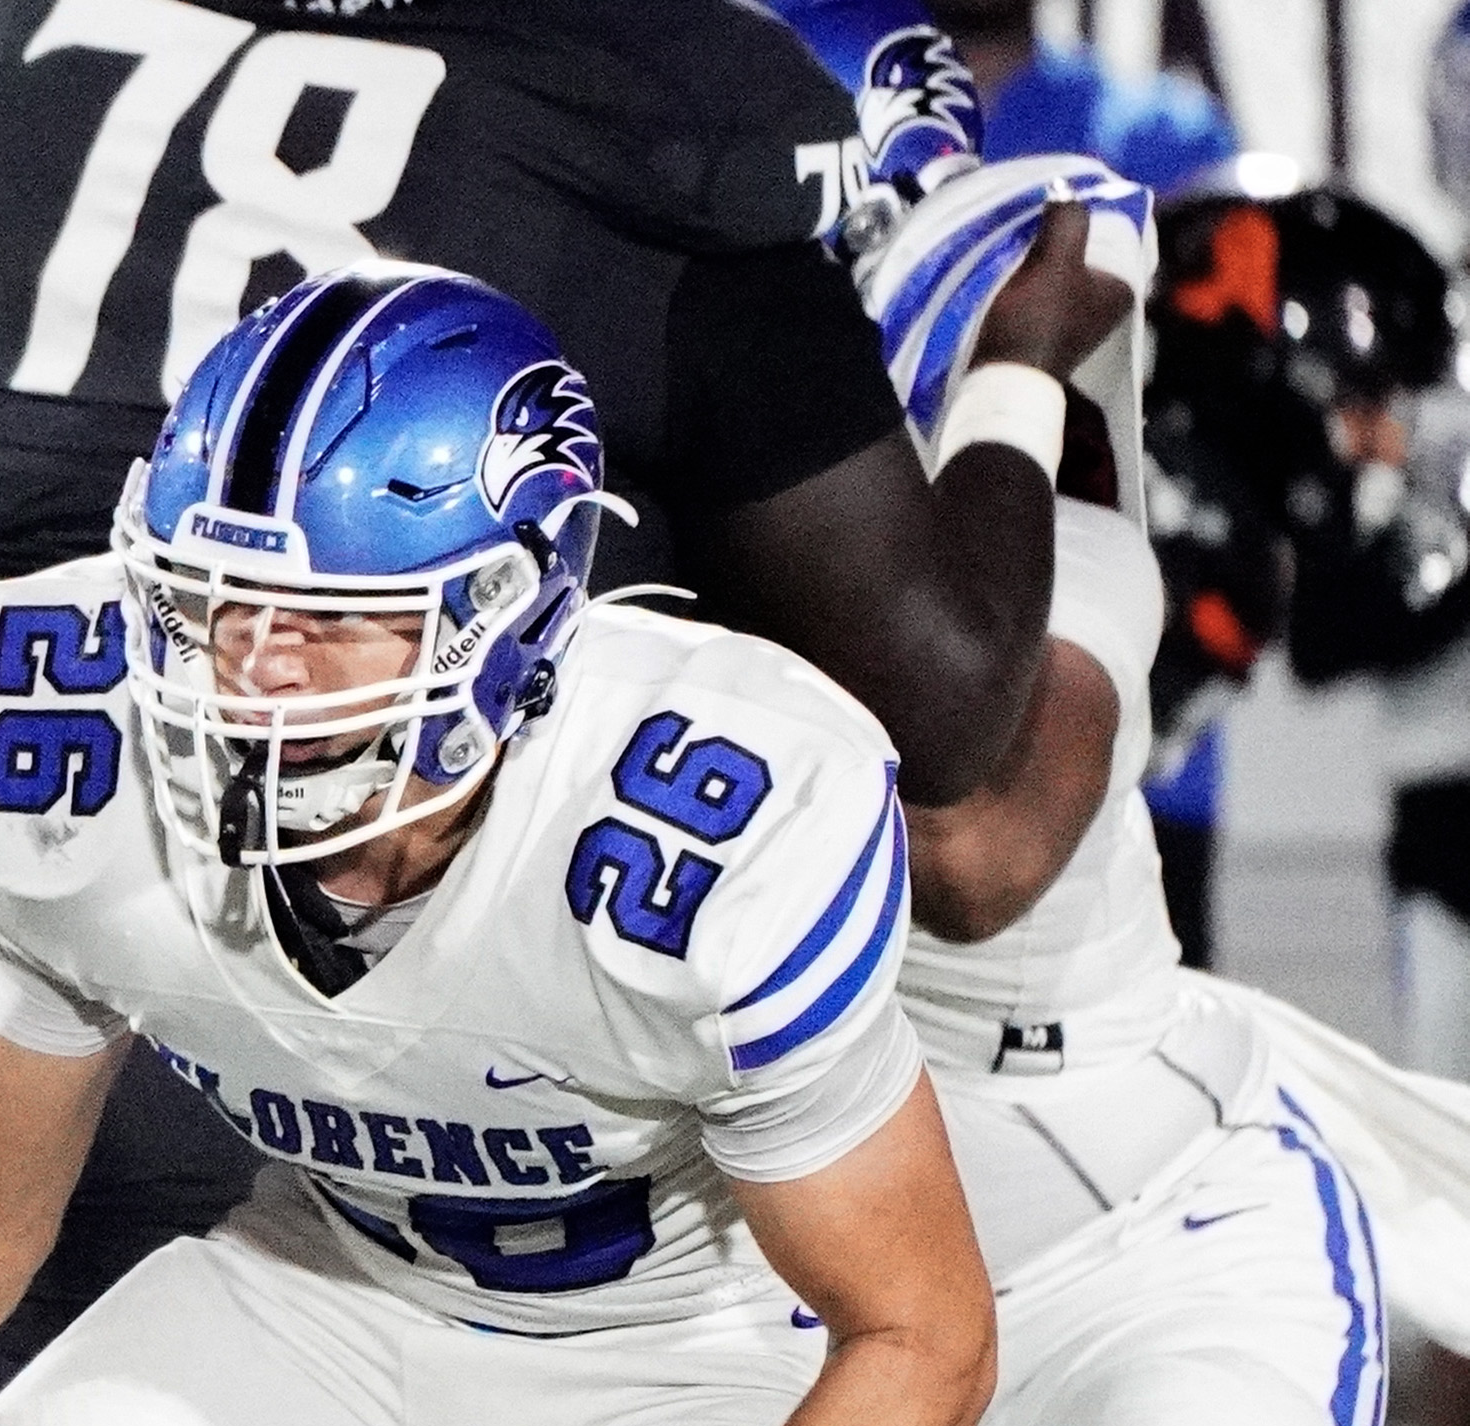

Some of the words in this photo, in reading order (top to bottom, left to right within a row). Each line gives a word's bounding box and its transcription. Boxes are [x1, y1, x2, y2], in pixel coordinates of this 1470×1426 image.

[10, 0, 447, 404] 78
[434, 621, 487, 675] ddell
[564, 709, 774, 961] 26
